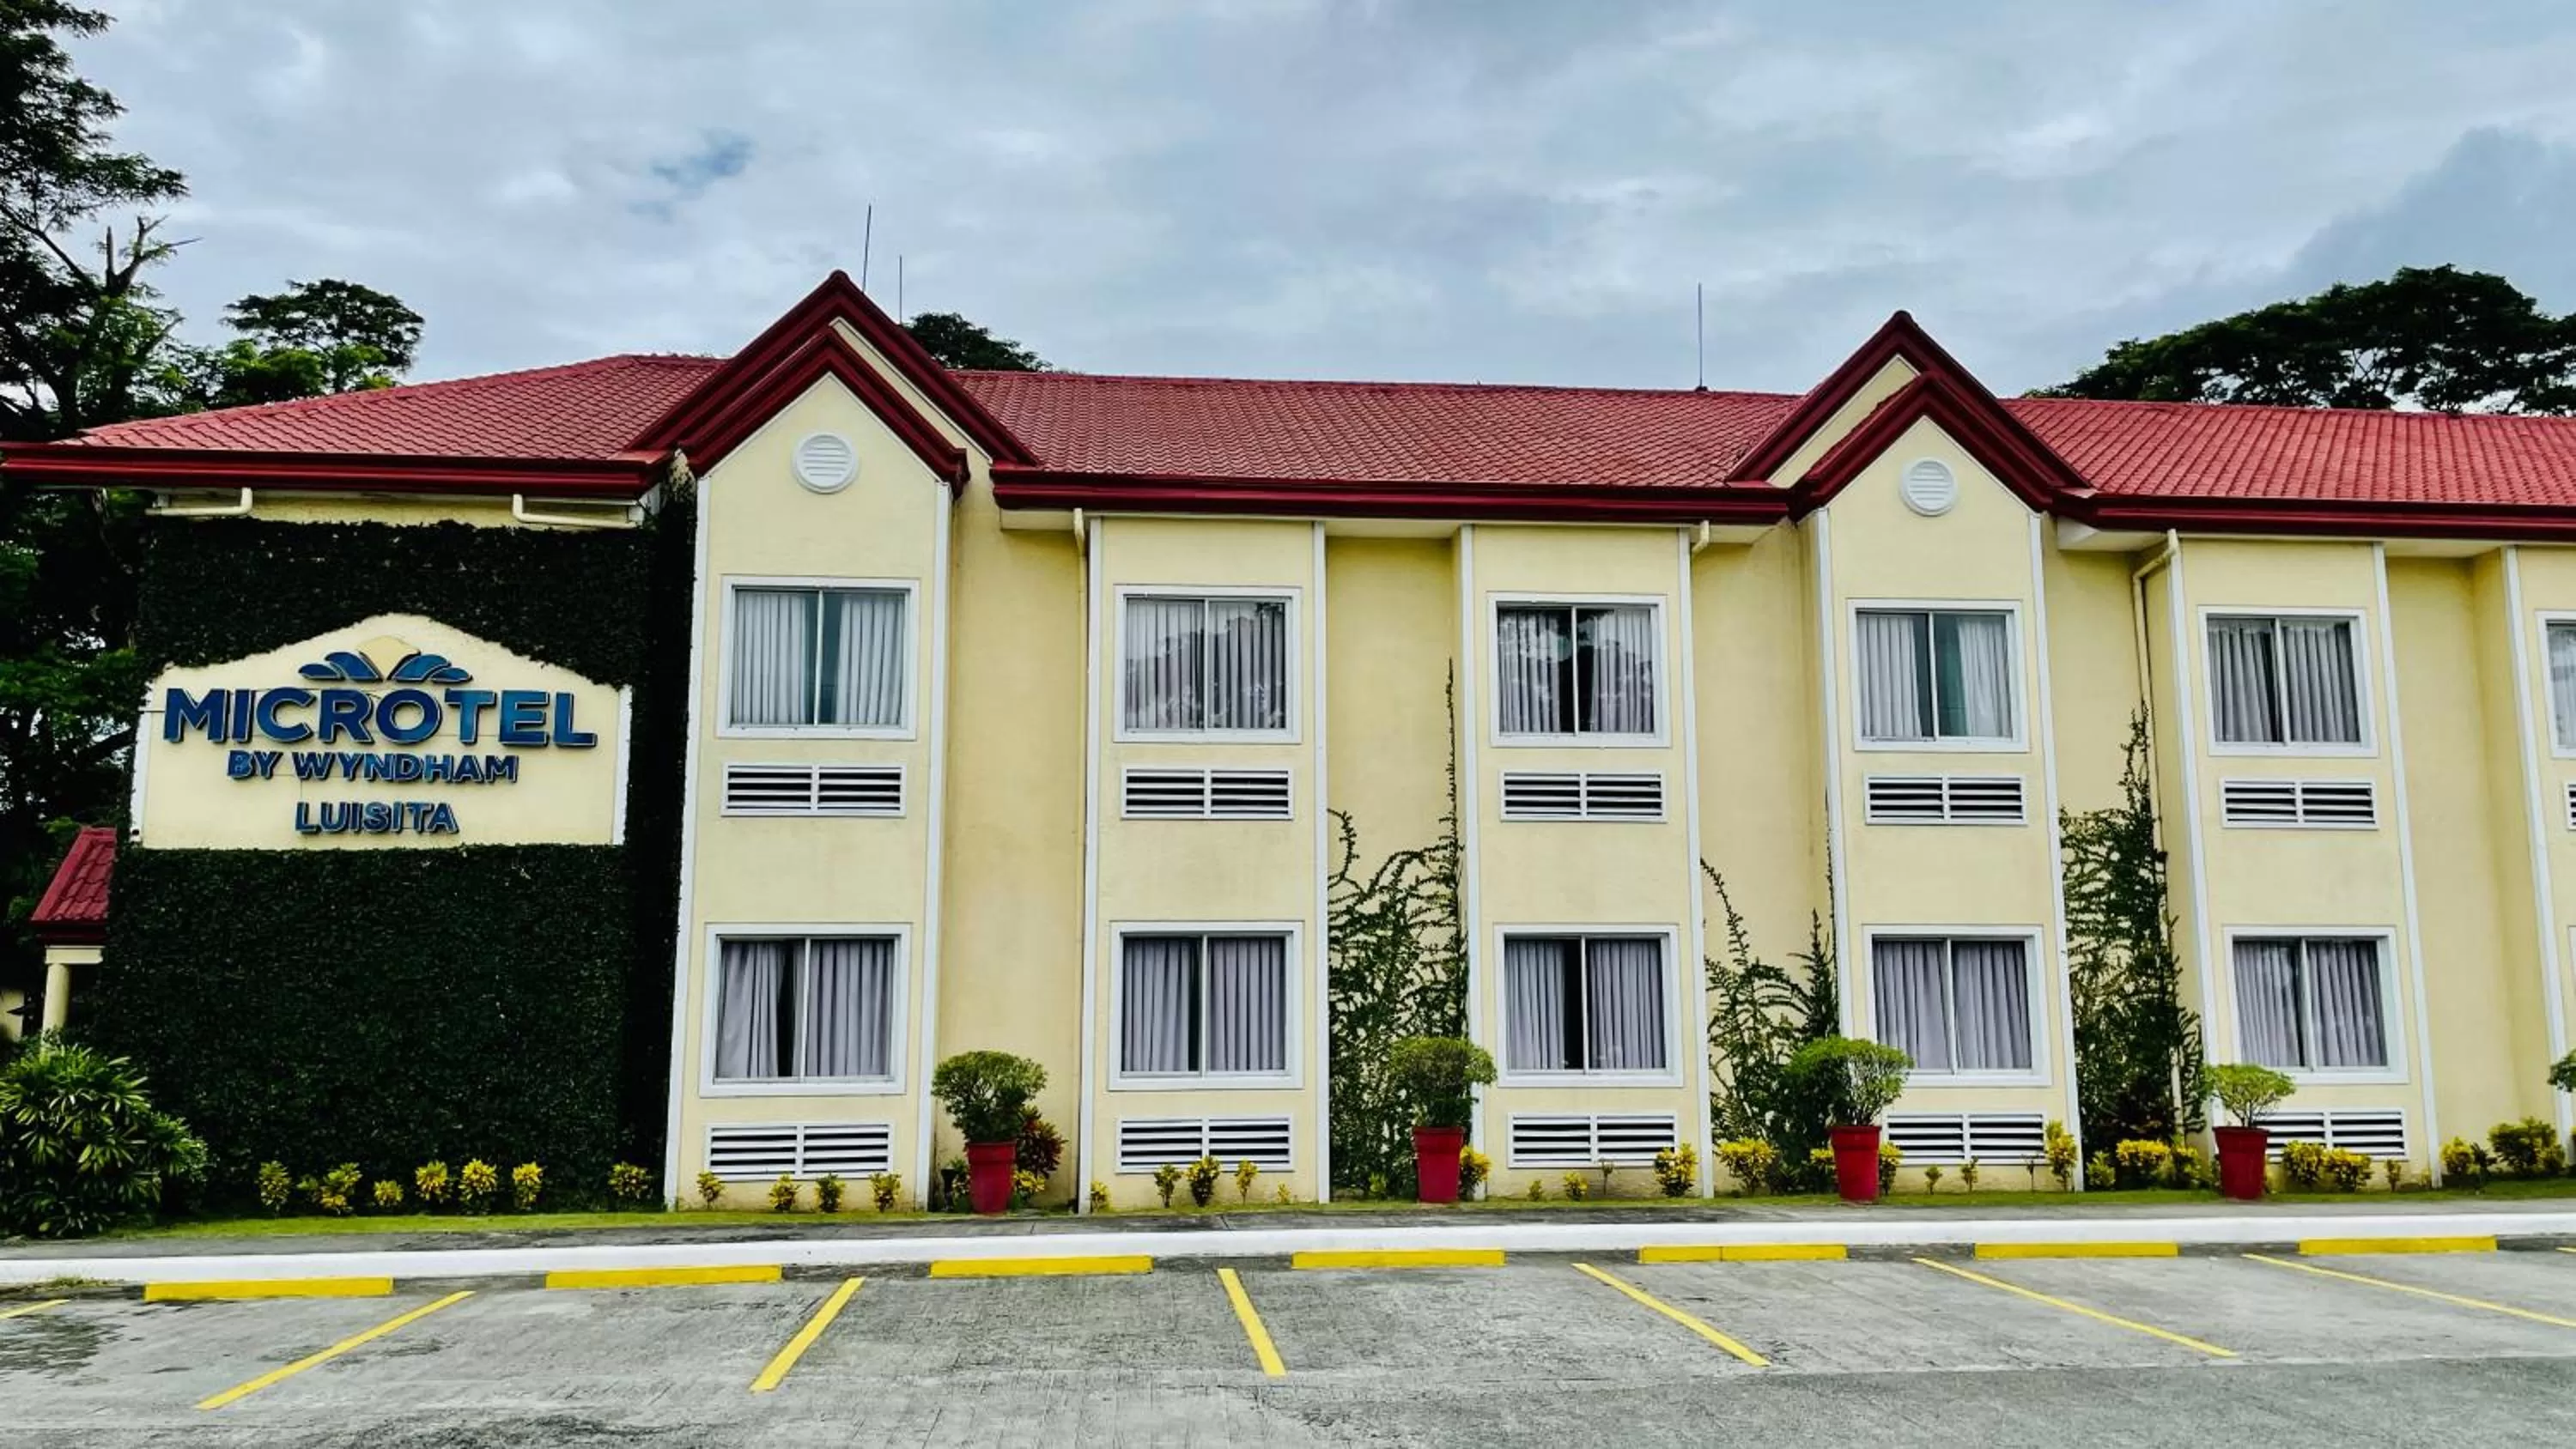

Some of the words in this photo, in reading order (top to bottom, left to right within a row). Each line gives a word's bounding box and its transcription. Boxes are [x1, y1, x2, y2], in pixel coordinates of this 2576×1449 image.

[162, 688, 598, 747] MICROTEL
[227, 749, 282, 779] BY
[293, 751, 519, 783] WYNDHAM
[295, 800, 459, 834] LUISITA
